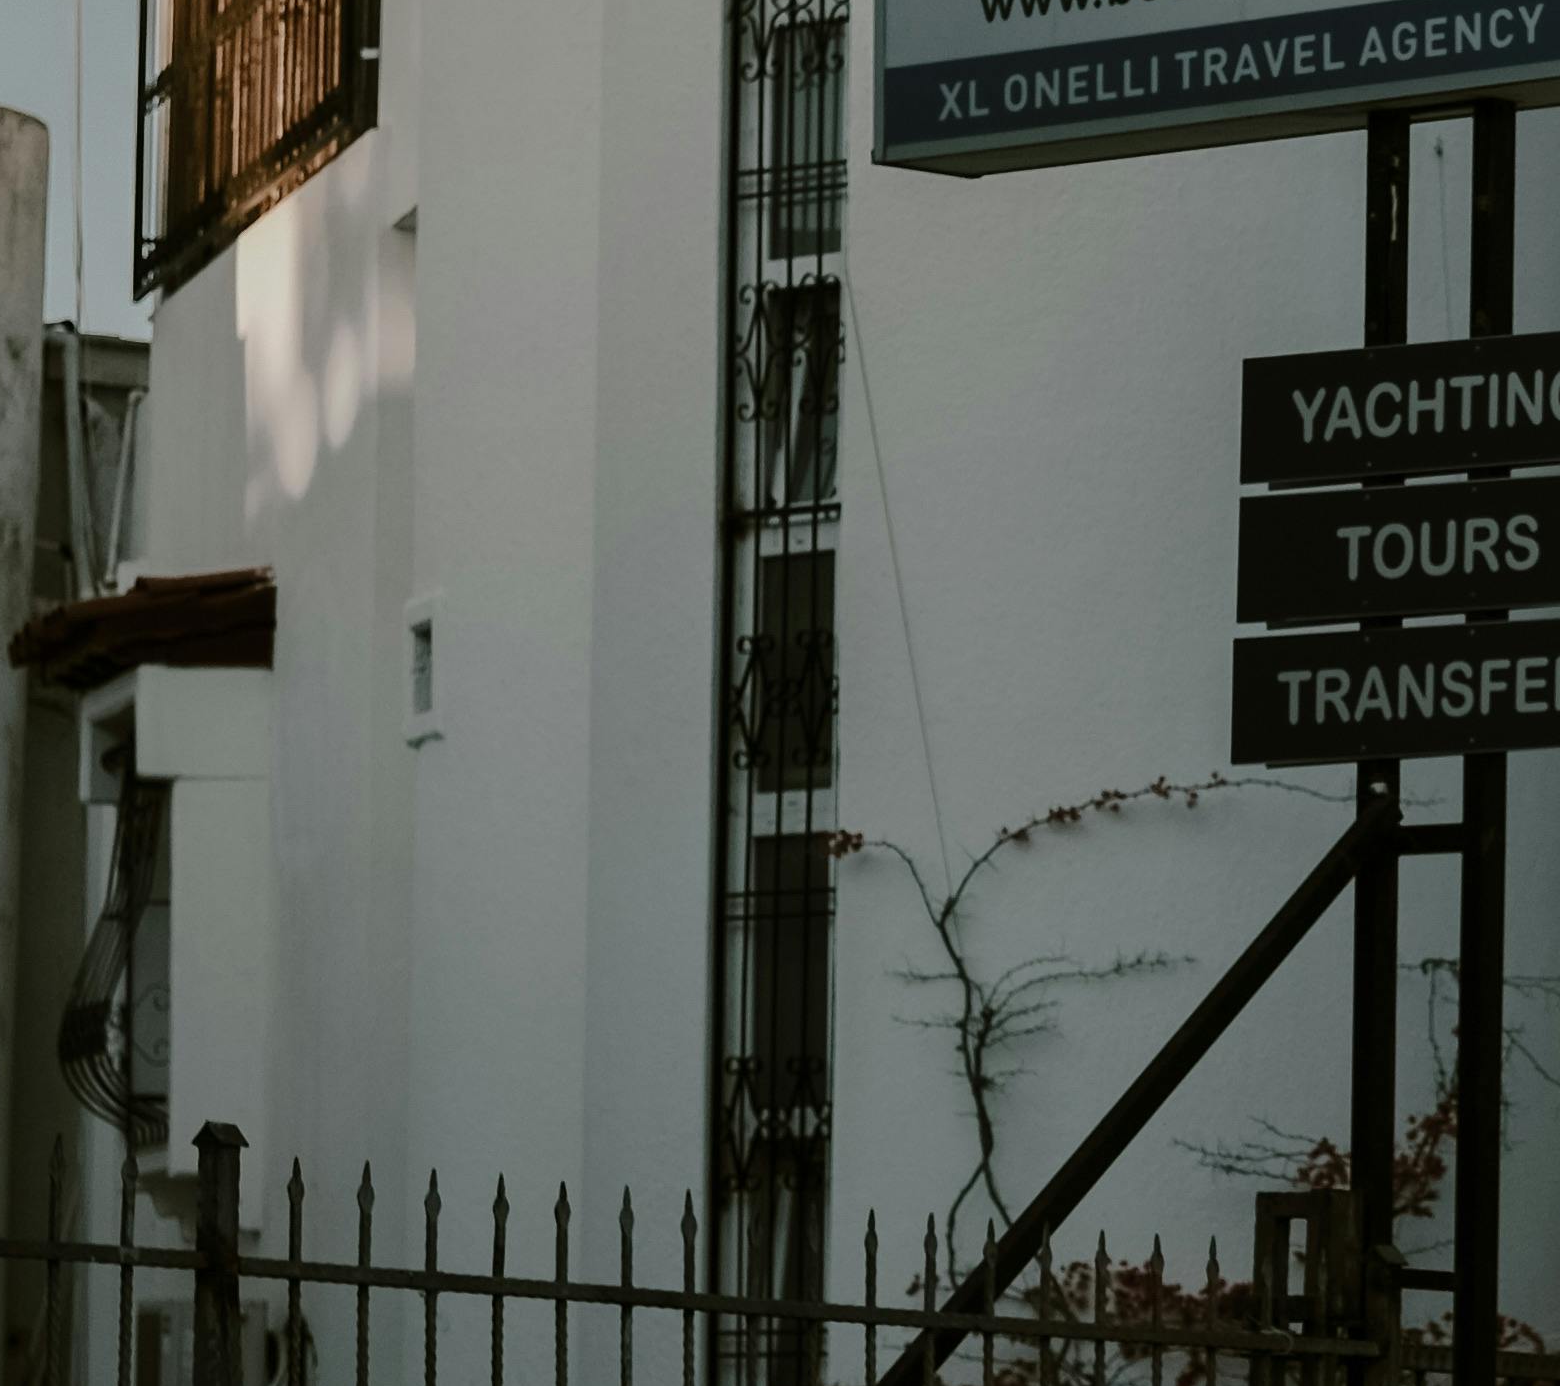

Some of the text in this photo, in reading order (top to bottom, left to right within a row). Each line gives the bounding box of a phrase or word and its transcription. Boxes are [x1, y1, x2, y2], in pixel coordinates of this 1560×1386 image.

[937, 3, 1546, 122] XL ONELLI TRAVEL AGENCY
[1336, 514, 1540, 581] TOURS
